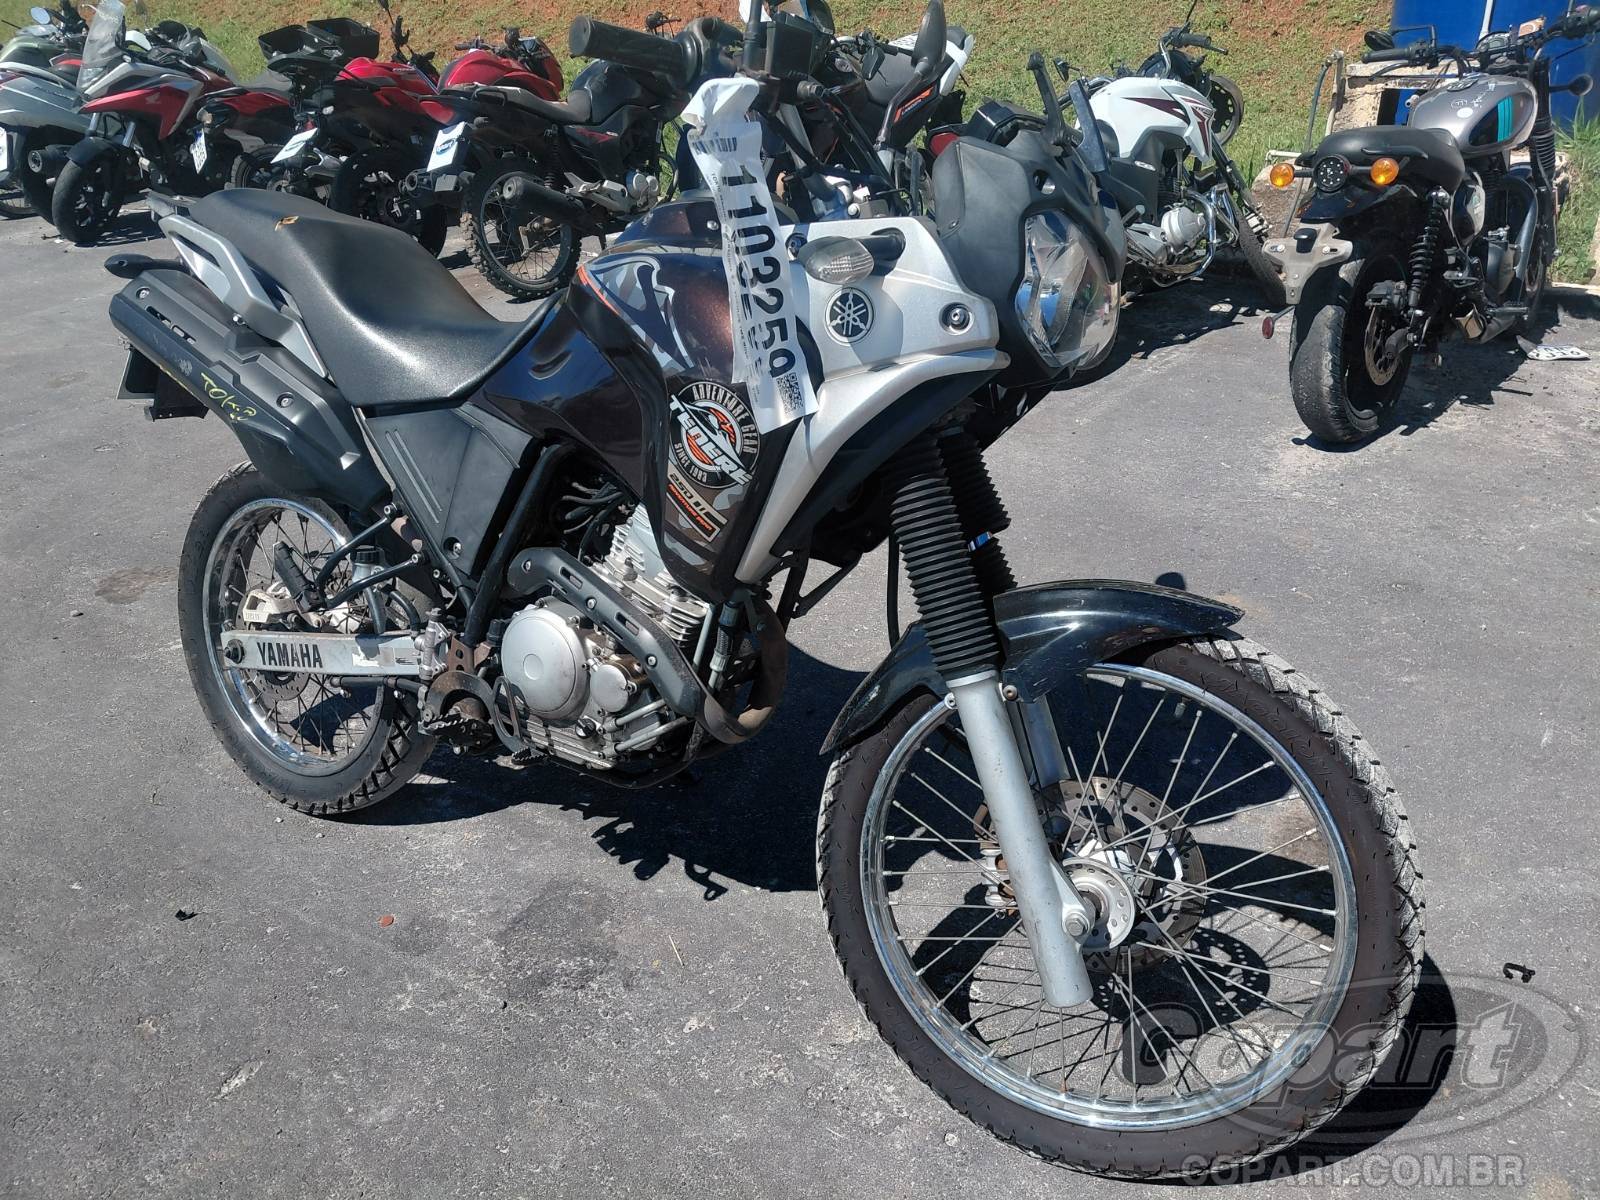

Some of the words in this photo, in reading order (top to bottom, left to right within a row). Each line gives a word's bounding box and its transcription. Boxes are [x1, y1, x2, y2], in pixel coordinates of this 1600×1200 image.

[692, 383, 747, 422] ADVENTURE
[740, 423, 758, 454] GEAR
[674, 442, 692, 468] SINCE
[256, 641, 323, 669] YAMAHA
